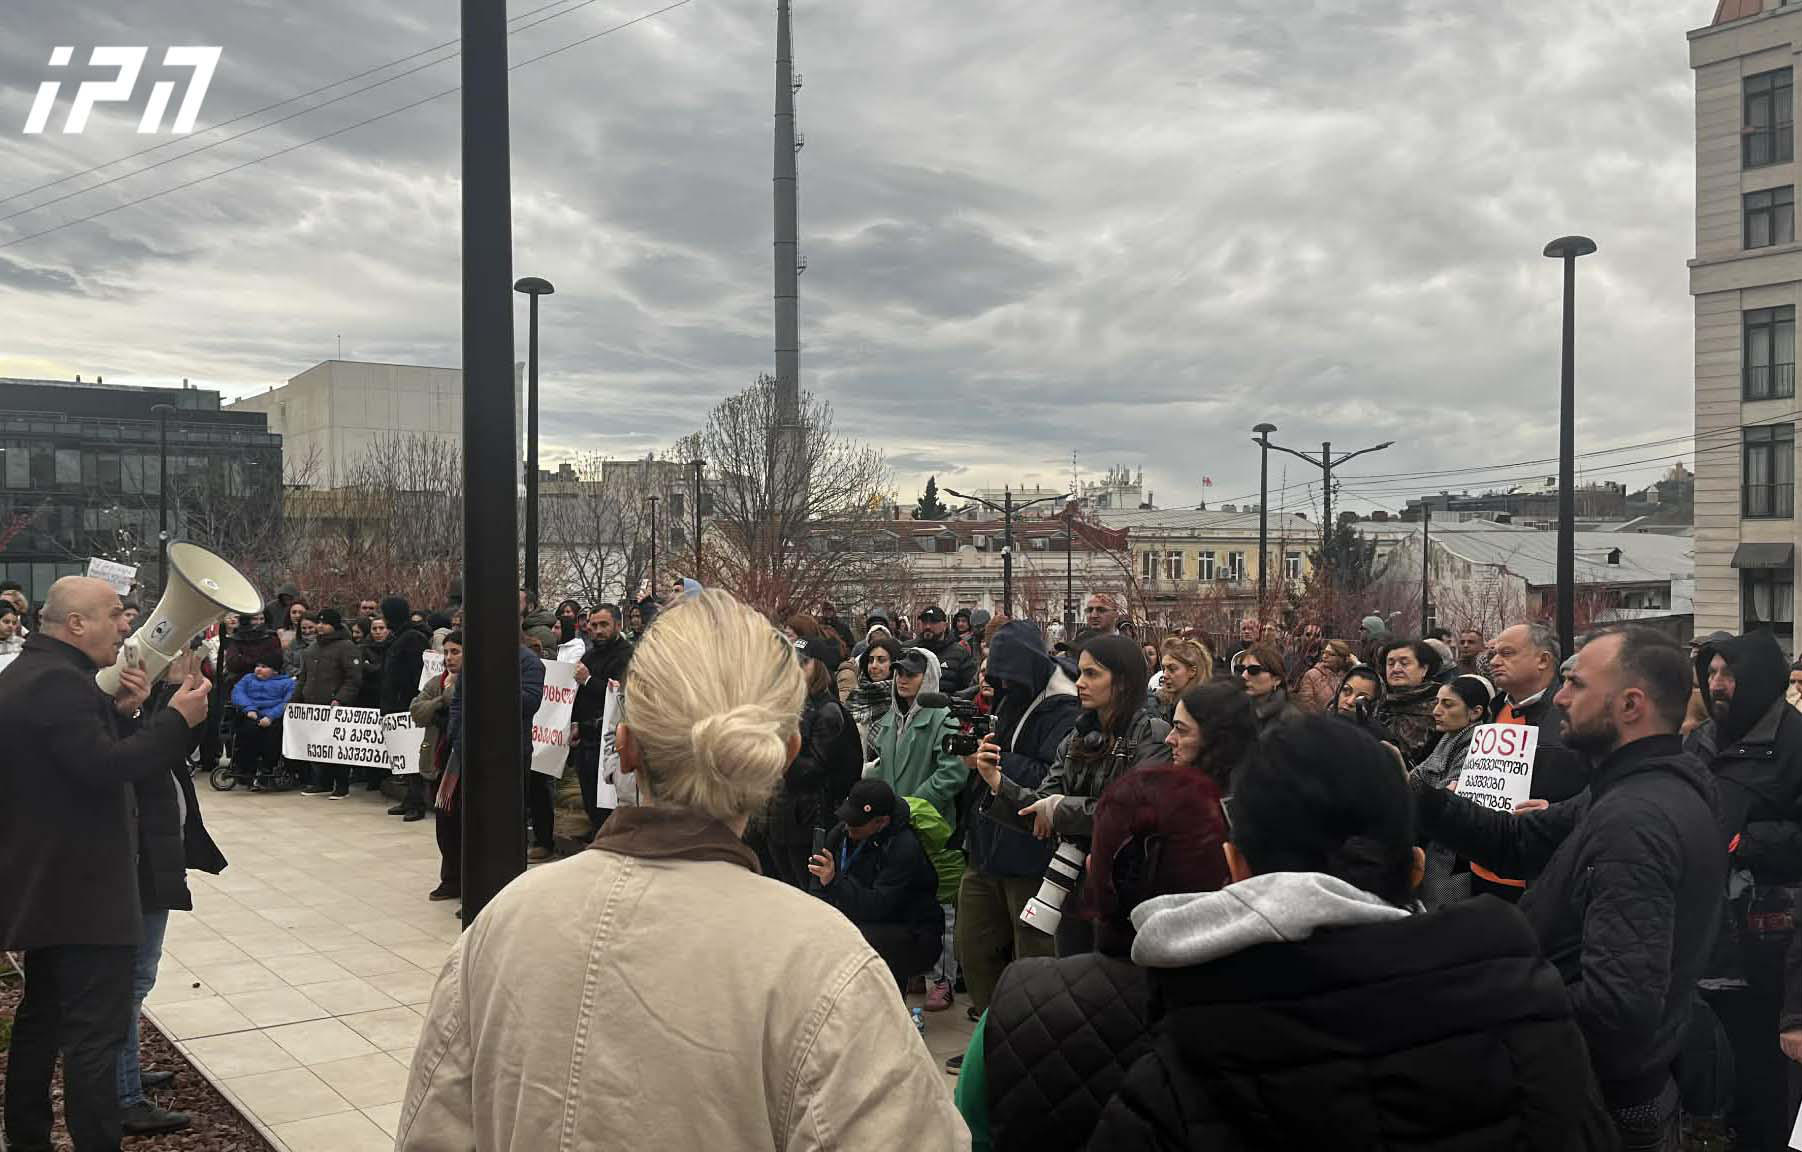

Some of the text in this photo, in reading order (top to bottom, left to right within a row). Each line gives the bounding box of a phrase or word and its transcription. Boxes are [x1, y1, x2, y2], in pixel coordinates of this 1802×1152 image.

[289, 706, 330, 721] გთხოვთ
[333, 727, 386, 744] და გადაა
[1471, 728, 1528, 757] SOS!
[307, 744, 388, 764] ჩვენი ბავშვები
